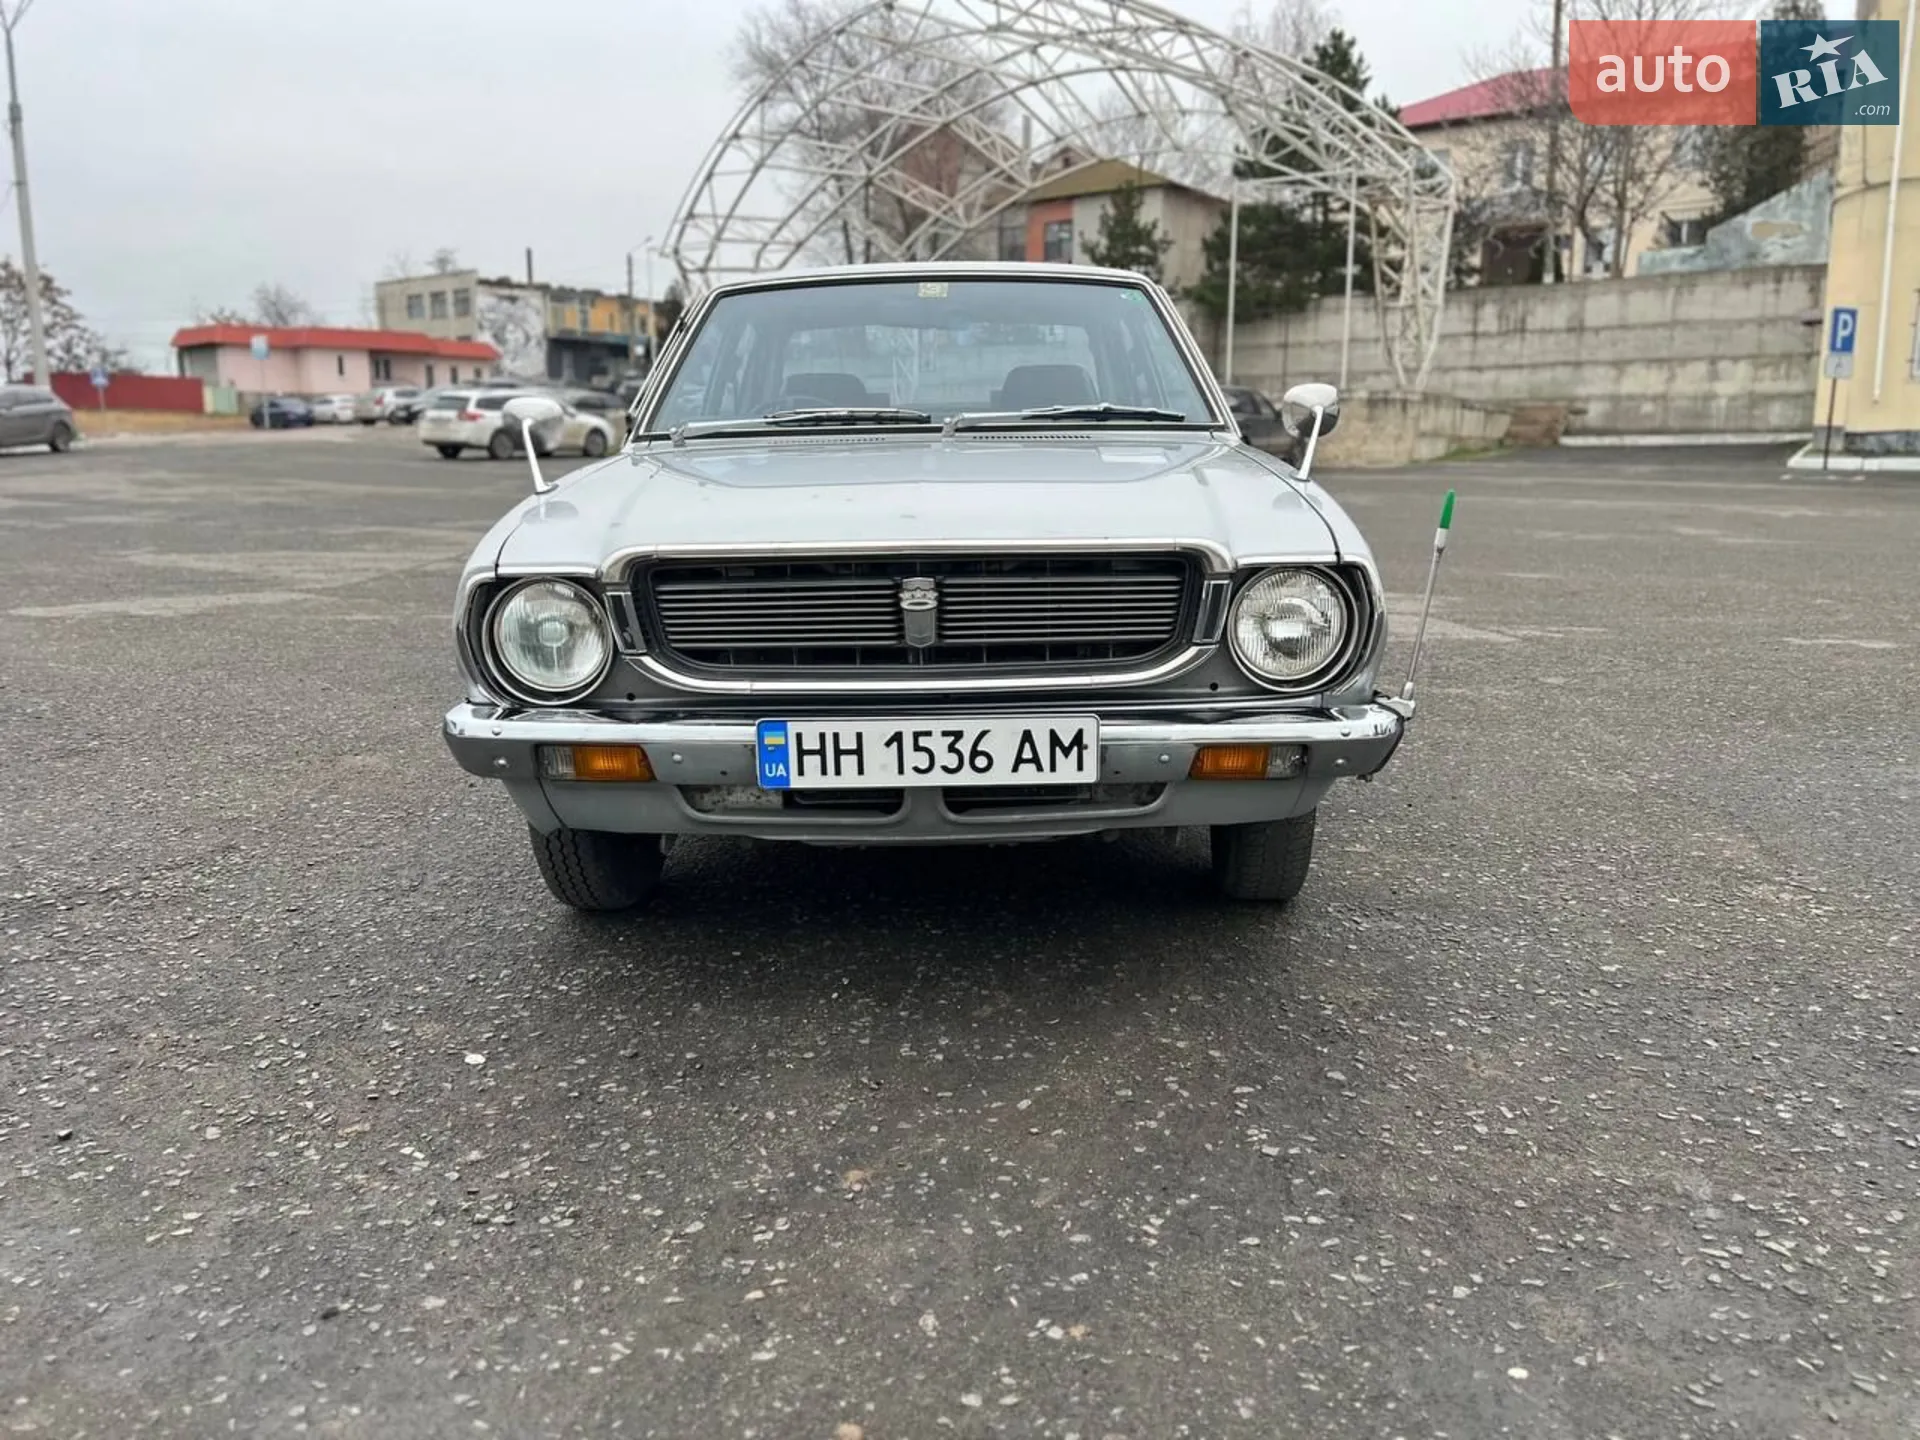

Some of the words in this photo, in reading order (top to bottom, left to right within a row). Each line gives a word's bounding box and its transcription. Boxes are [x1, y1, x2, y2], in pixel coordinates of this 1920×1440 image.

[1835, 312, 1853, 349] P
[765, 763, 788, 778] UA
[883, 729, 994, 776] 1536
